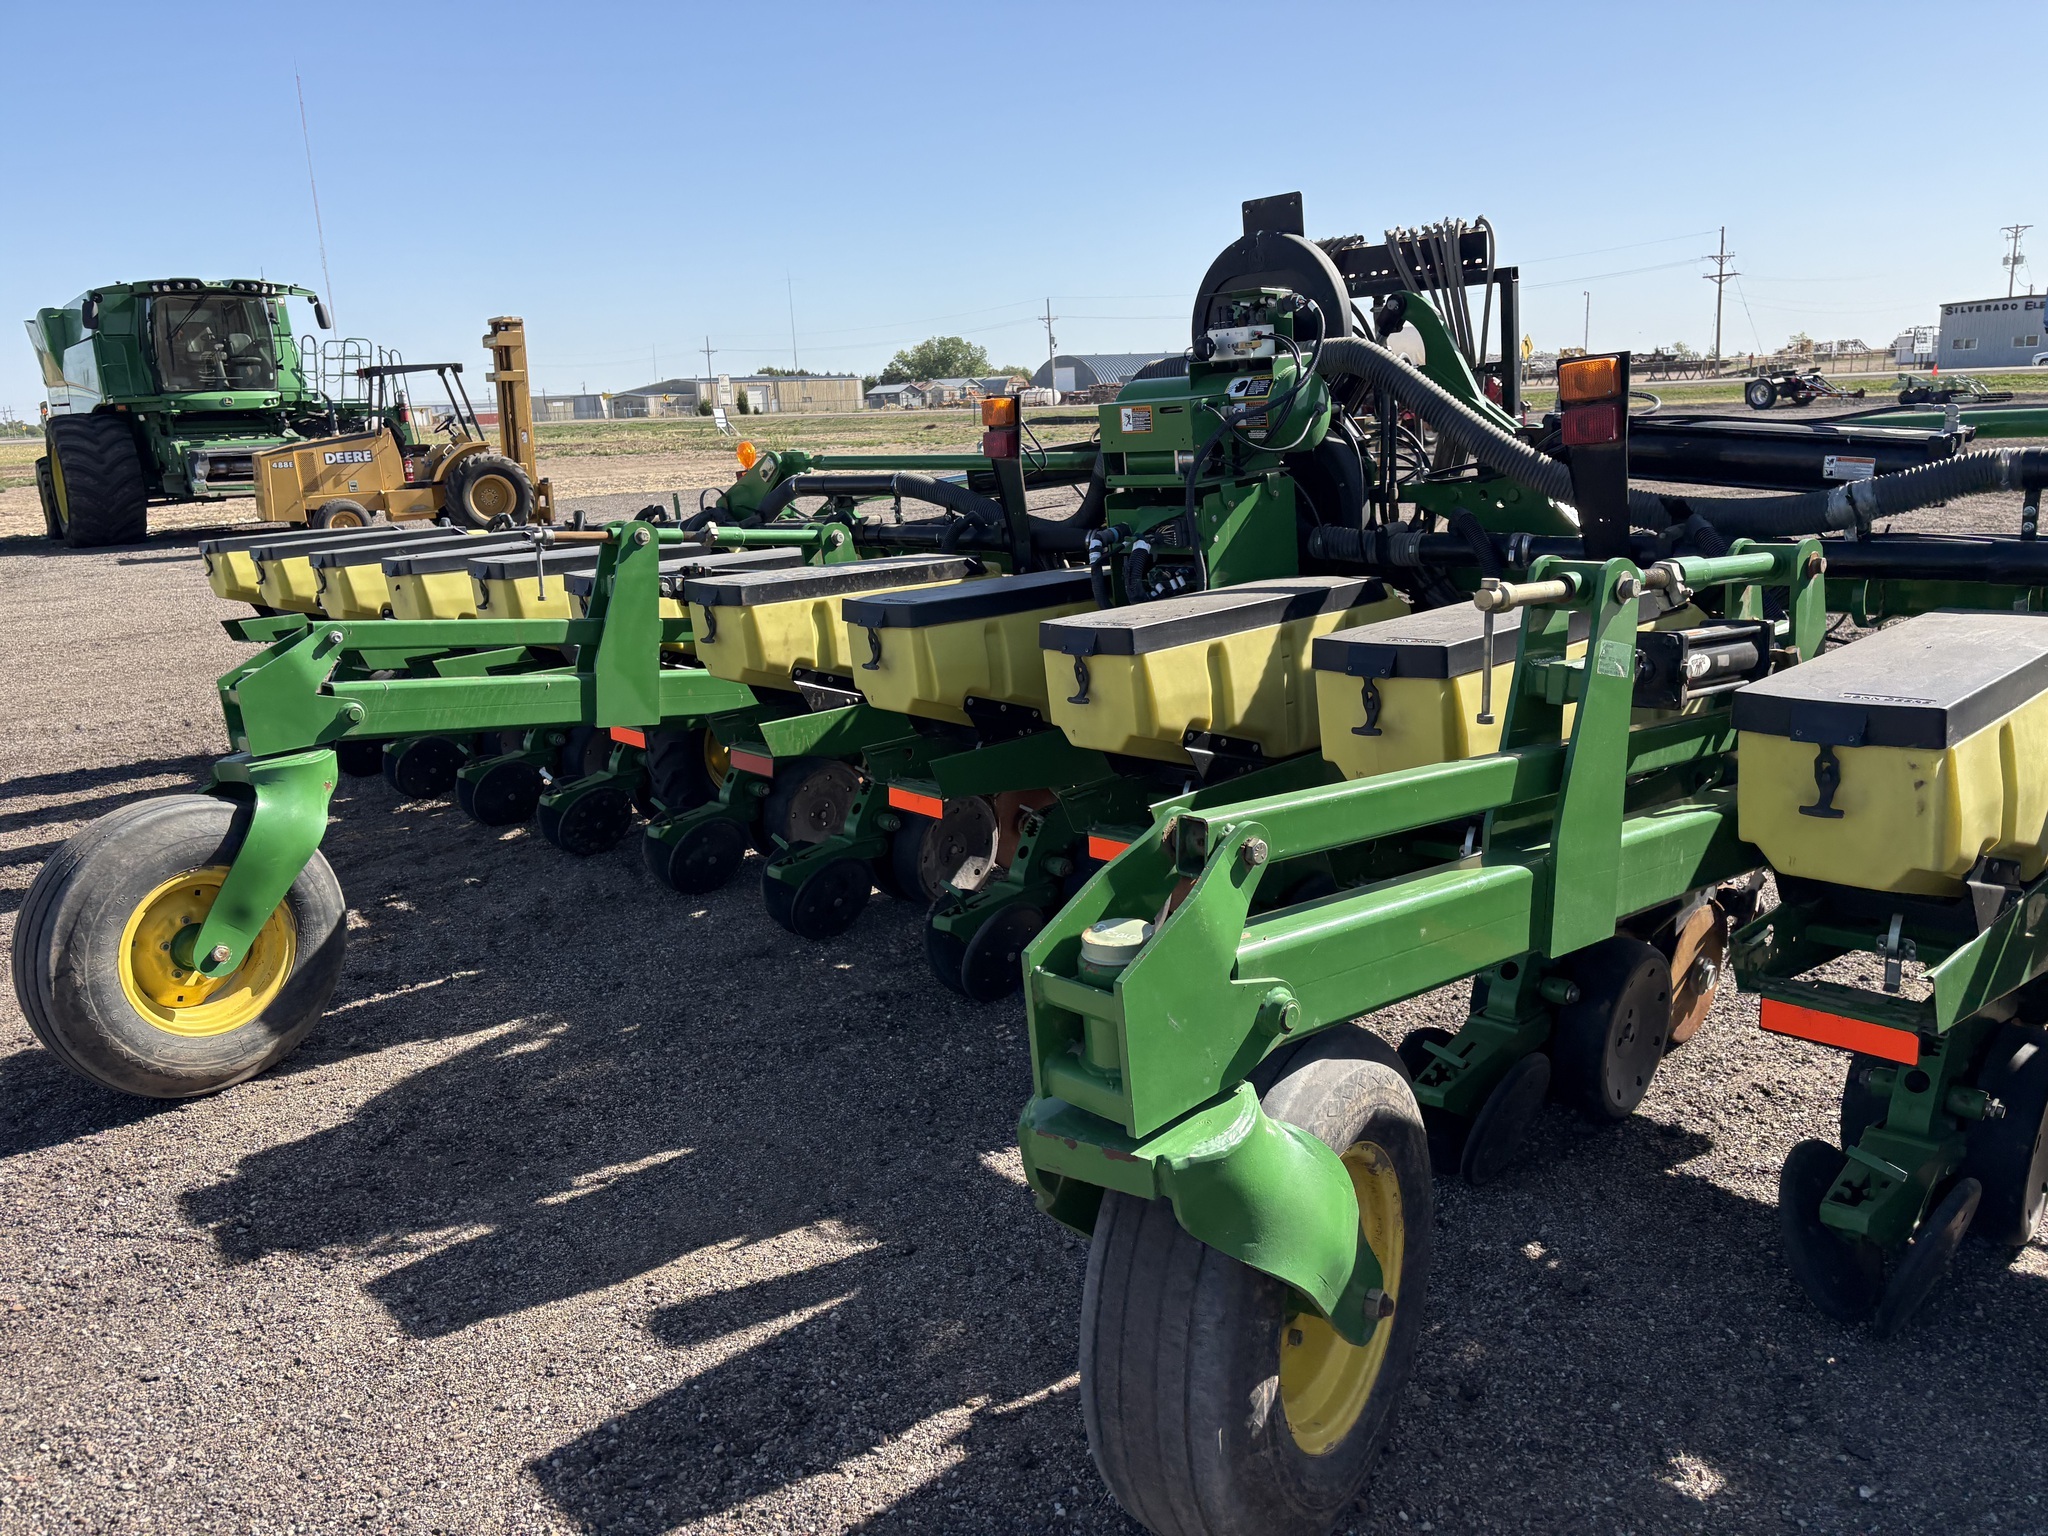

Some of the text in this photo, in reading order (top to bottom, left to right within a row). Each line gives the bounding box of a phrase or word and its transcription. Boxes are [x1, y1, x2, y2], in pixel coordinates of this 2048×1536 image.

[1945, 303, 2018, 315] SILVERADO
[324, 450, 372, 465] DEERE
[272, 461, 293, 469] 488E
